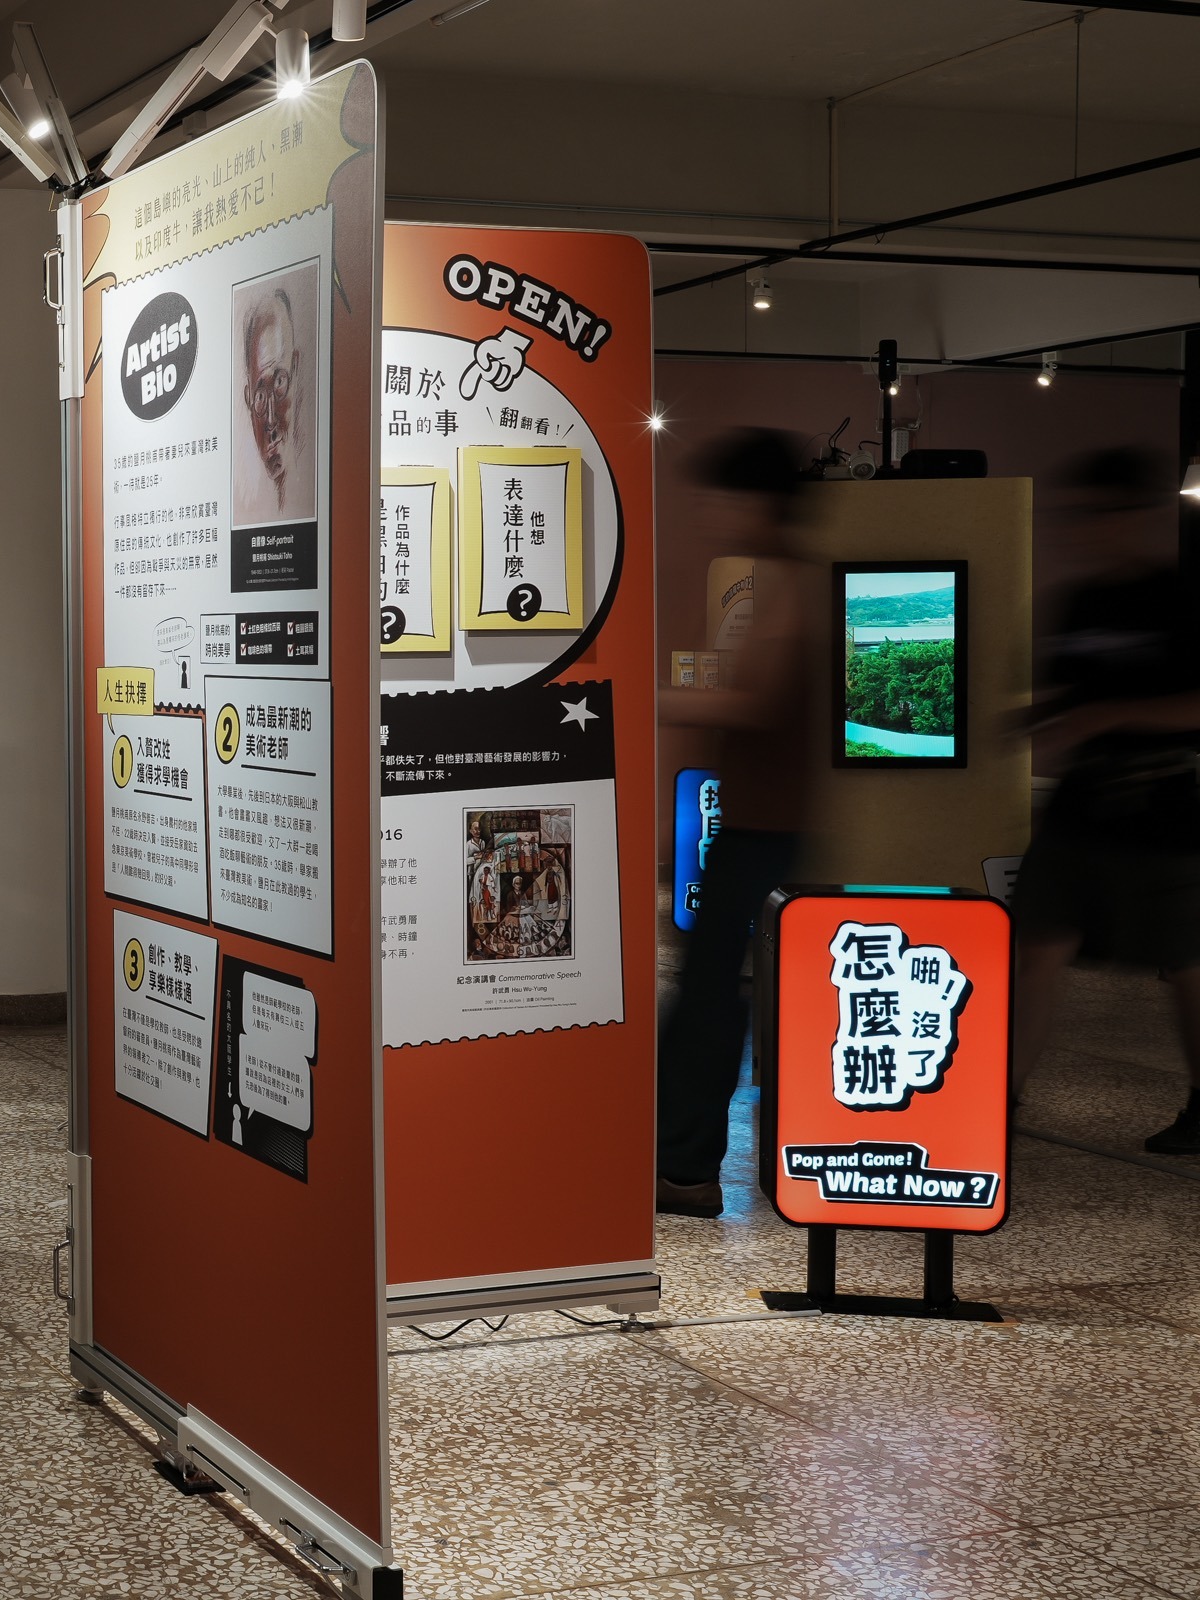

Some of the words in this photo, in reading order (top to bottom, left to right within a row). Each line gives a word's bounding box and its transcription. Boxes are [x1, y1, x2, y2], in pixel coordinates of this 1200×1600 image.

[449, 260, 607, 357] OPEN!
[126, 313, 190, 377] Artist
[141, 364, 177, 405] Bio
[385, 364, 446, 401] 關於
[388, 408, 459, 437] 品的事
[499, 406, 561, 436] 翻翻看!
[503, 477, 524, 579] 表達什麼
[530, 511, 545, 546] 他想
[394, 505, 410, 595] 作品為什麼
[104, 679, 147, 705] 人生抉擇
[246, 704, 312, 732] 成為最新潮的
[137, 737, 171, 760] 入贅改姓
[222, 717, 232, 752] 2
[246, 733, 289, 760] 美術老師
[137, 763, 188, 790] 獲得求學機會
[386, 770, 452, 782] 不斷流傳下來。
[381, 828, 403, 840] 16
[129, 949, 138, 982] 3
[149, 943, 198, 977] 創作、教學、
[149, 970, 192, 1004] 享樂樣樣通
[457, 975, 496, 985] 紀念演講會
[498, 972, 555, 982] Commemorative
[557, 971, 582, 979] Speech
[841, 932, 902, 1095] 怎麼辦
[792, 1153, 823, 1169] Pop
[826, 1152, 858, 1166] and
[862, 1152, 912, 1167] Gone!
[826, 1171, 897, 1196] What
[904, 1175, 965, 1199] Now
[970, 1176, 986, 1200] ?
